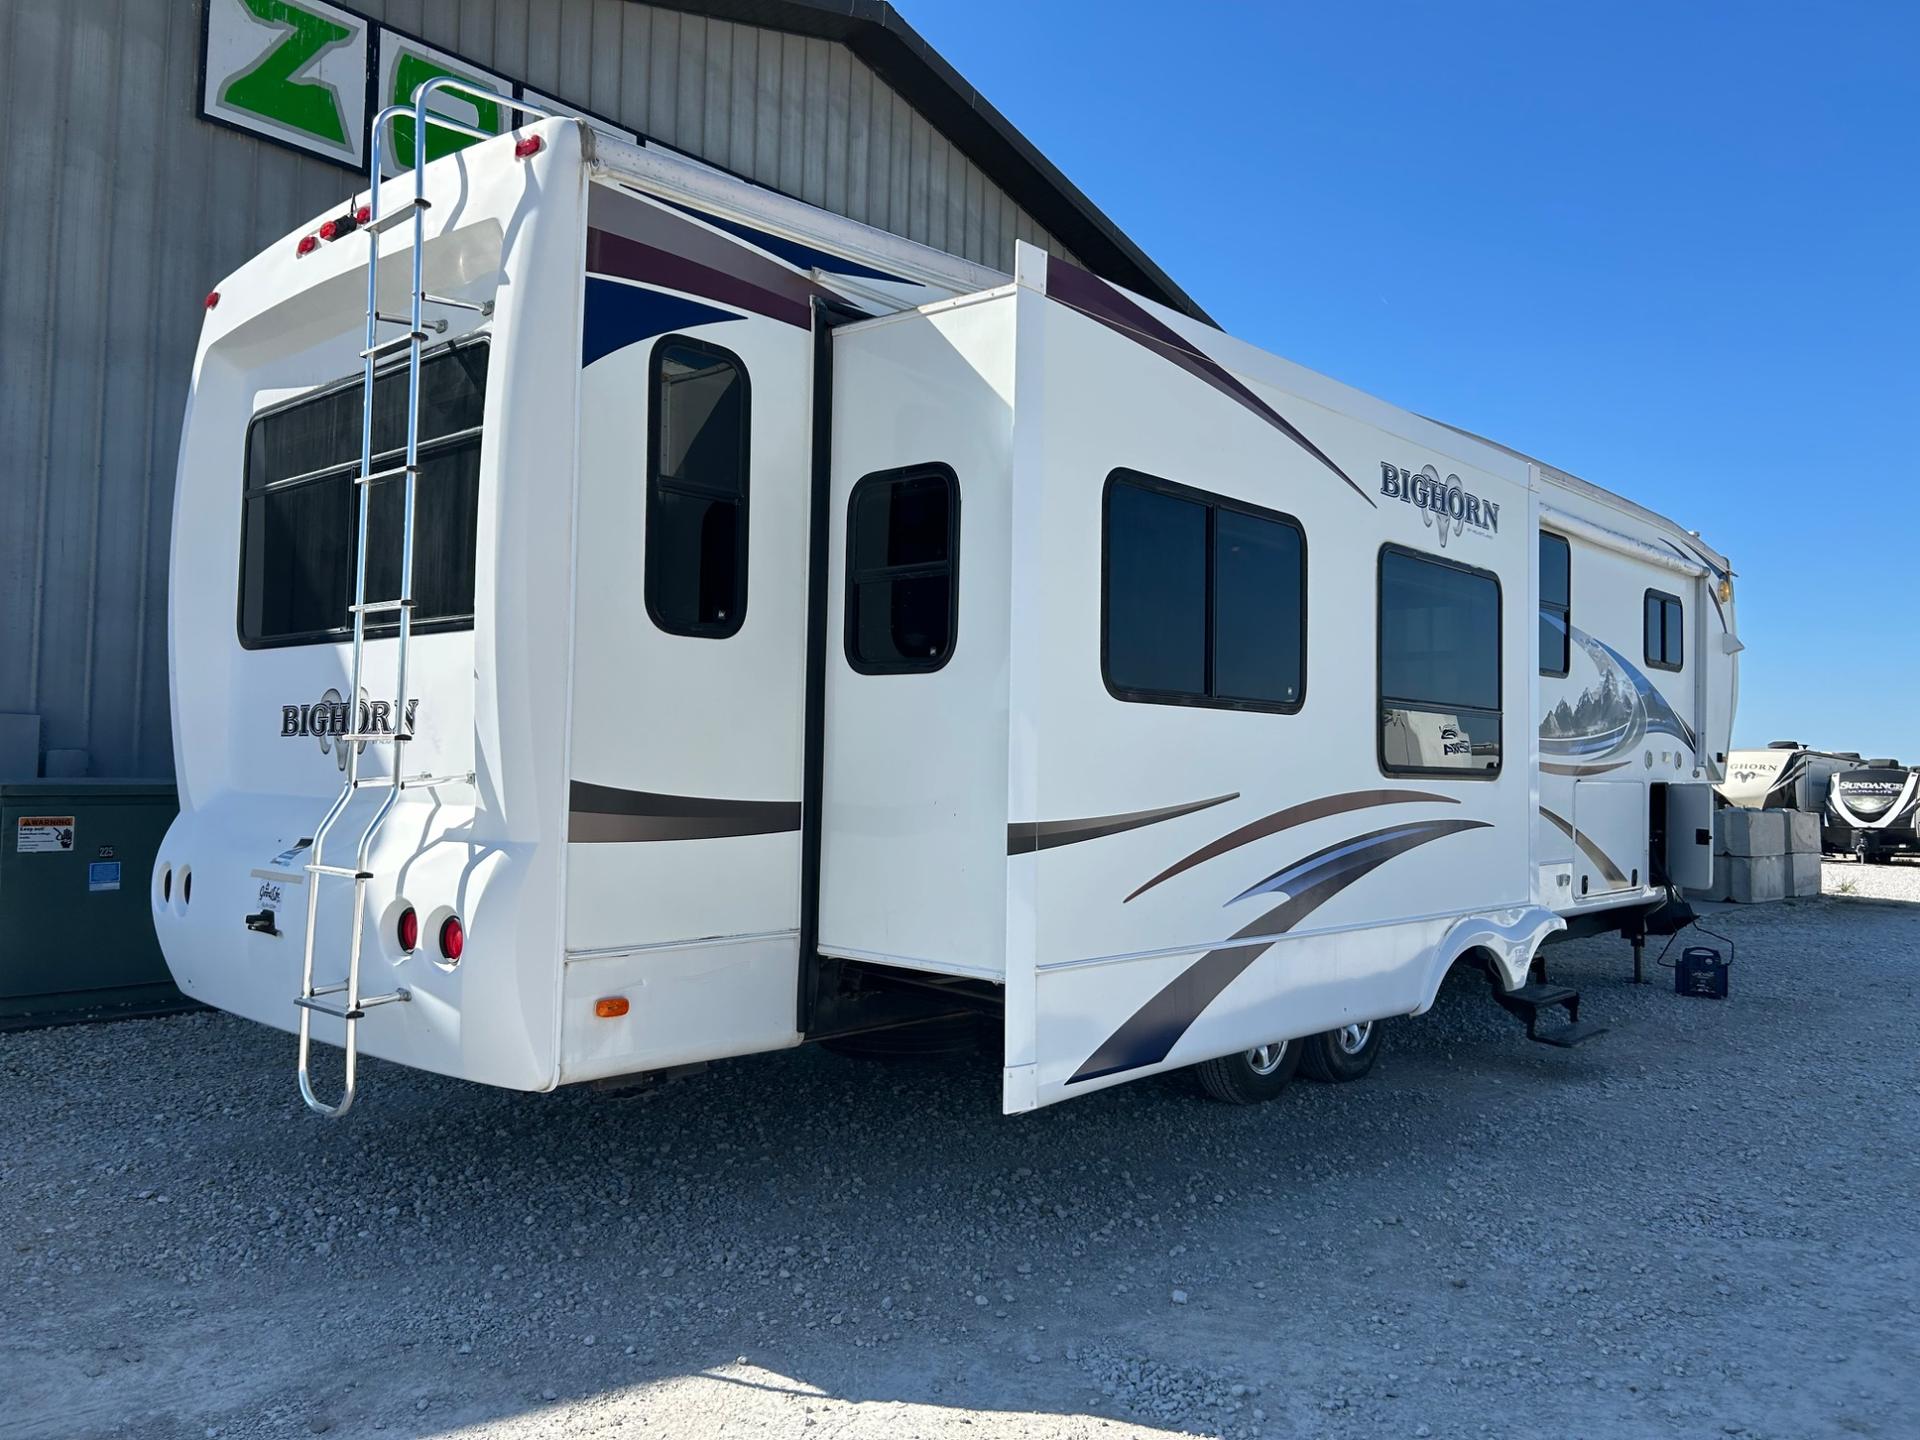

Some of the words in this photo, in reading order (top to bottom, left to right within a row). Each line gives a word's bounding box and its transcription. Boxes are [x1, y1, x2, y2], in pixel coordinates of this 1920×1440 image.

[215, 0, 505, 172] ZO
[1380, 460, 1500, 534] BIGHORN
[1840, 781, 1904, 791] SUNDANCE
[31, 818, 72, 826] WARNING
[100, 847, 113, 857] 225
